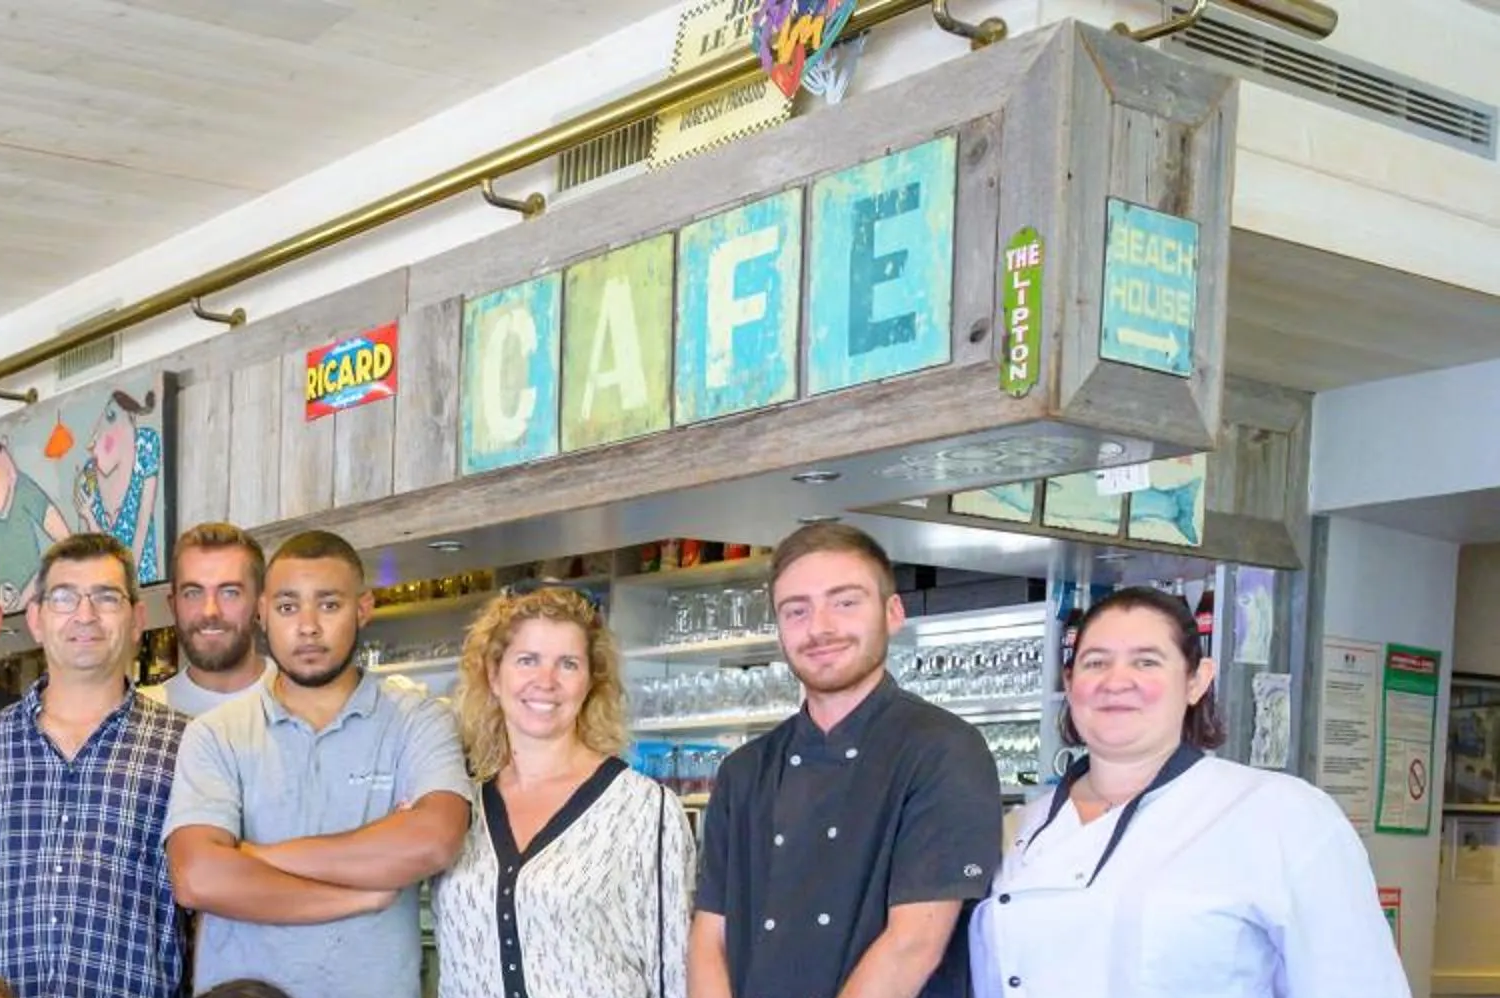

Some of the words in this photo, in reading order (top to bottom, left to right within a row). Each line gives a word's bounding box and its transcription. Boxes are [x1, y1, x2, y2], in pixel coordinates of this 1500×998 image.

[1111, 222, 1195, 279] BEACH
[483, 182, 921, 442] CAFE
[1009, 270, 1032, 382] LIPTON
[1110, 278, 1191, 327] HOUSE
[306, 342, 393, 401] RICARD
